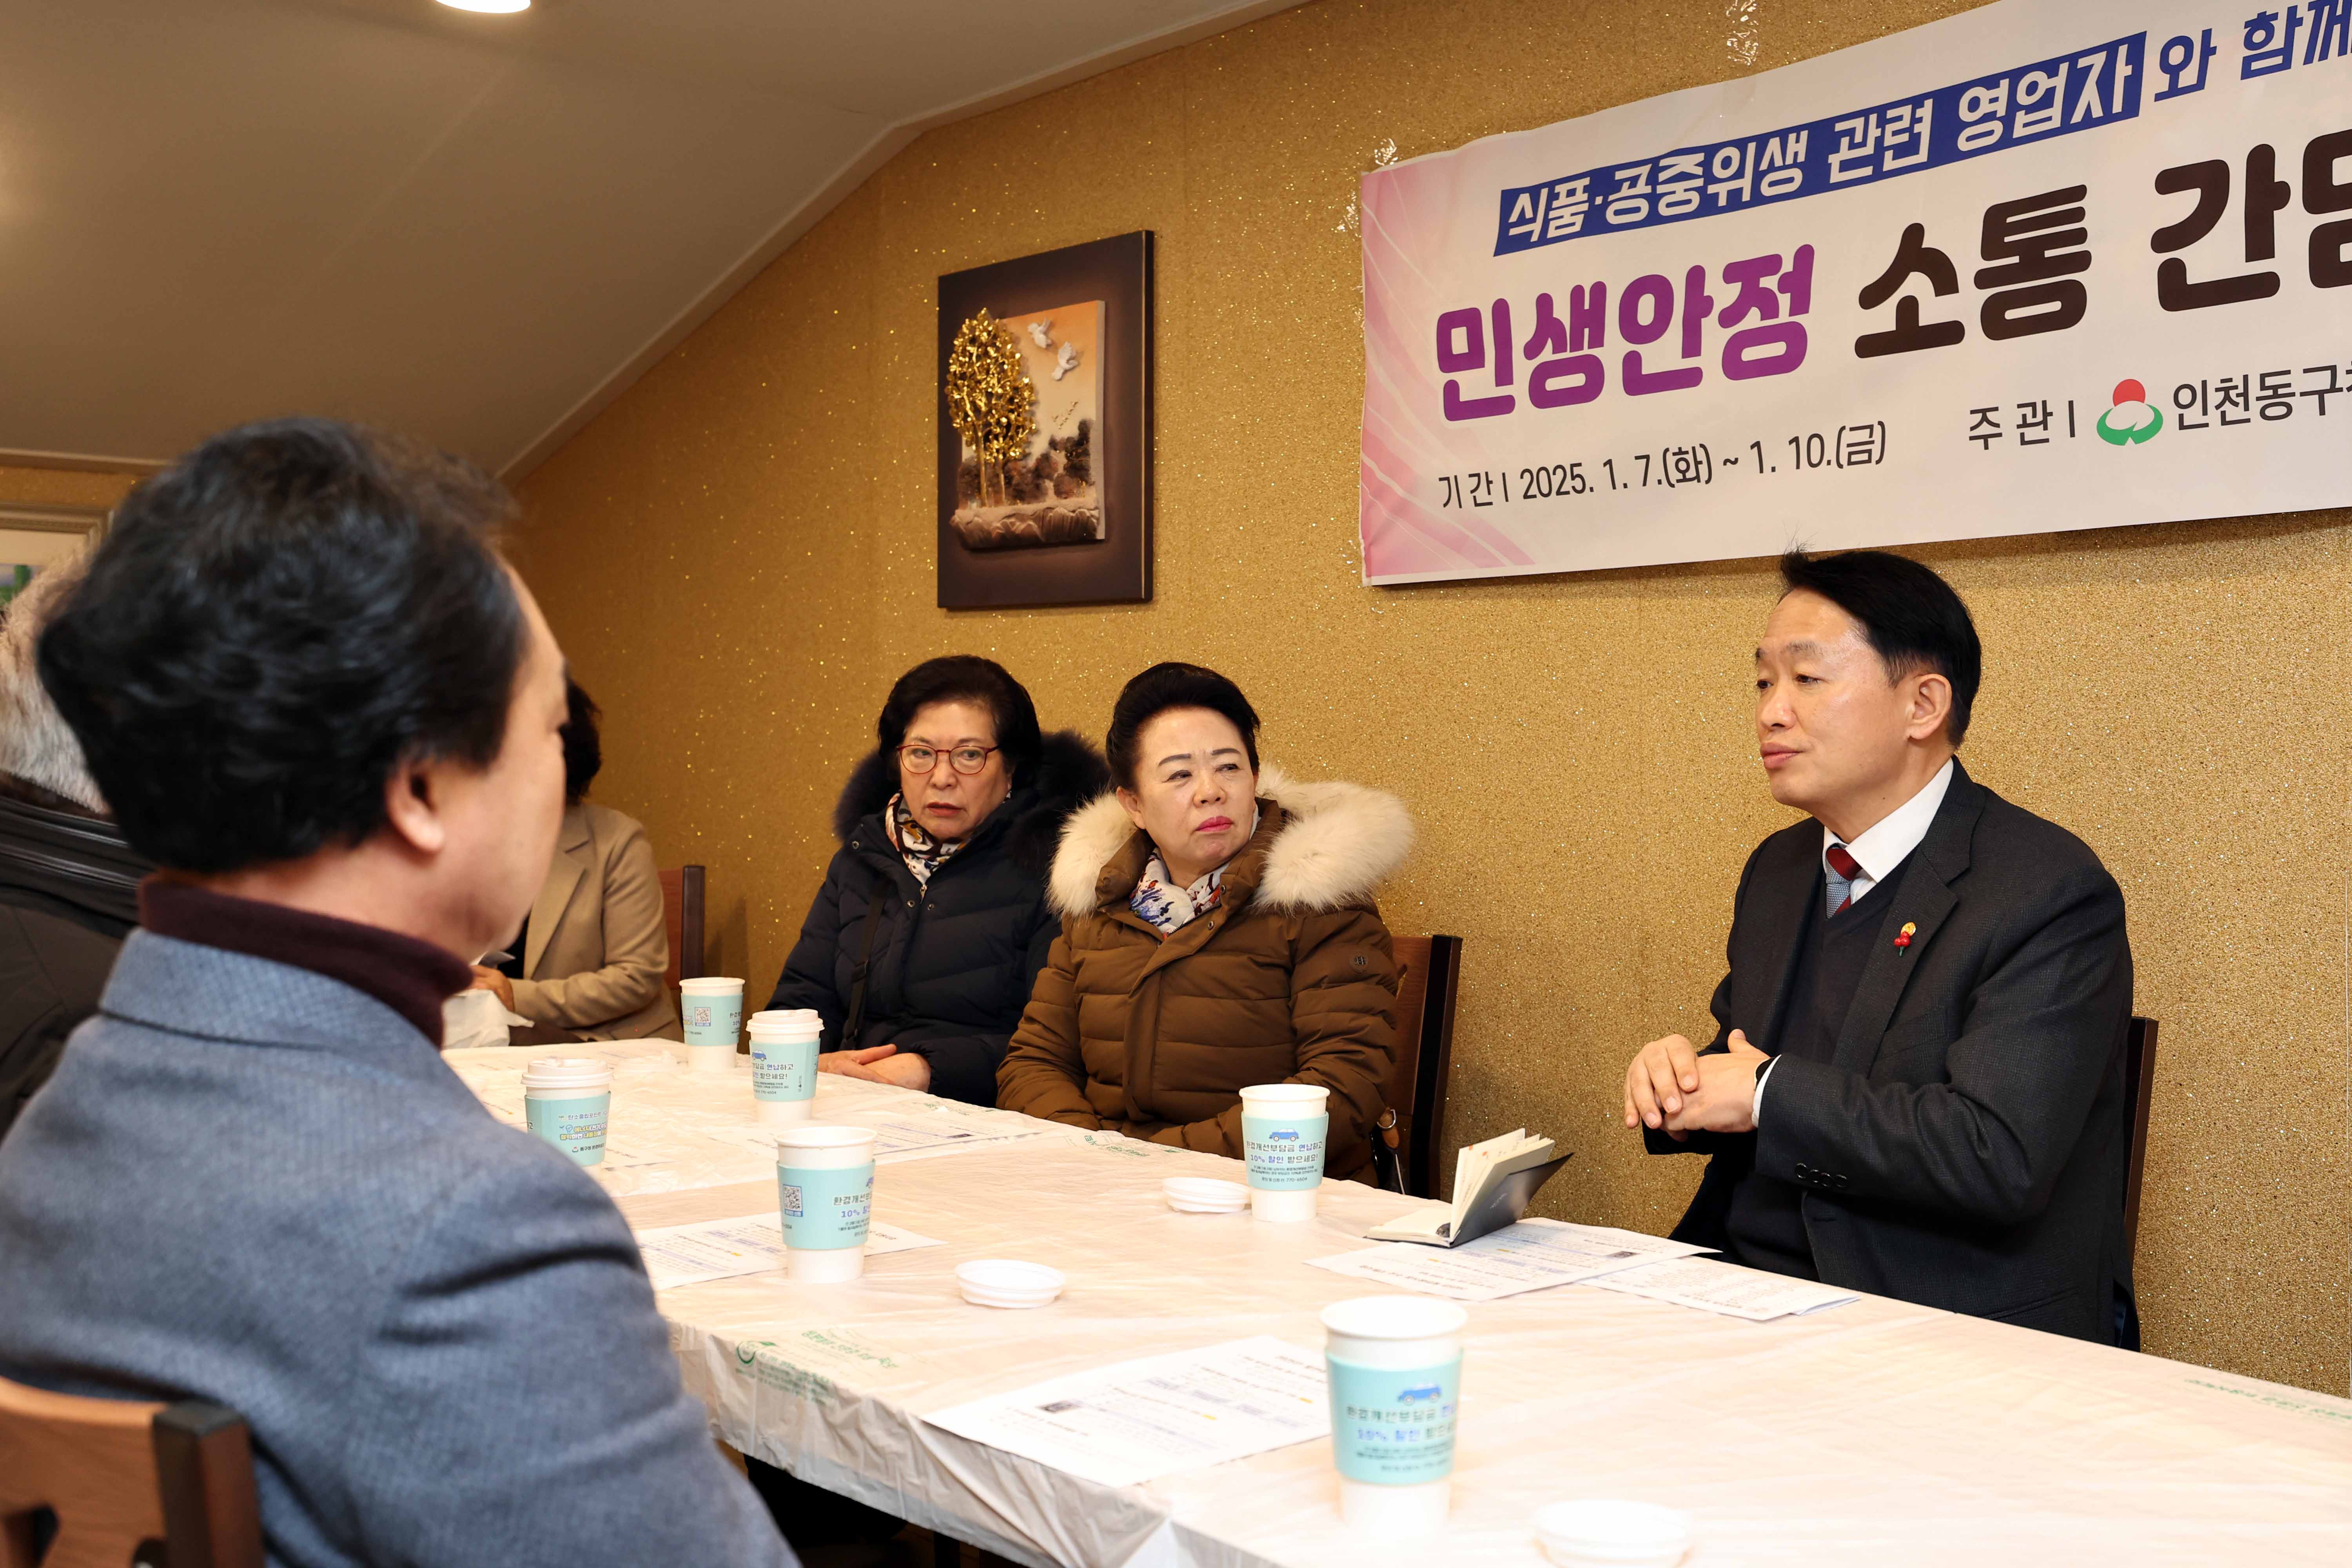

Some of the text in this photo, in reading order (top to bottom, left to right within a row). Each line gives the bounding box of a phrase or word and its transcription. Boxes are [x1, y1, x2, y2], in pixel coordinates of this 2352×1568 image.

[1508, 130, 1808, 243] 식품·공중위생
[1828, 98, 1933, 184] 관련
[2240, 0, 2352, 80] 함께
[1436, 244, 1815, 421] 민생안정
[1855, 184, 2092, 359] 소통
[2173, 360, 2352, 430] 인천동구
[1438, 471, 1493, 508] 기간
[1520, 462, 1594, 499] 2025.
[1603, 459, 1628, 490] 1.
[1634, 443, 1712, 488] 7.(화)
[1750, 441, 1776, 474] 1.
[1788, 421, 1886, 470] 10.(금)
[1247, 1141, 1322, 1152] 환경개선부담금 연납하고
[1250, 1154, 1318, 1164] 10% 할인 받으세요!
[833, 1192, 872, 1206] 환경개선부
[840, 1209, 860, 1218] 10%
